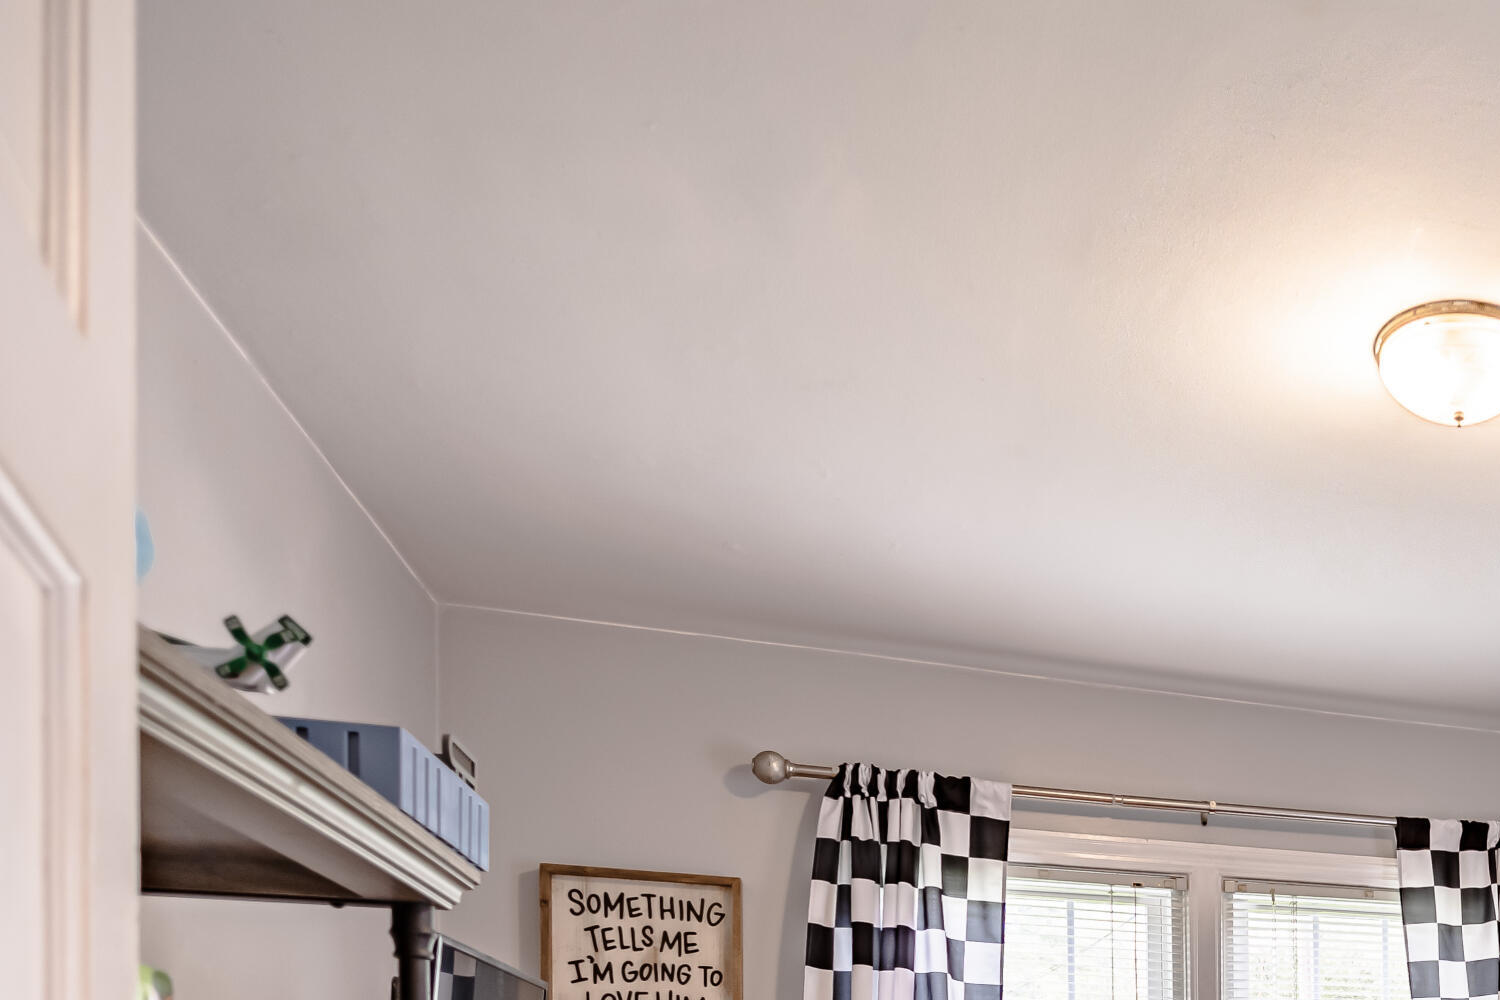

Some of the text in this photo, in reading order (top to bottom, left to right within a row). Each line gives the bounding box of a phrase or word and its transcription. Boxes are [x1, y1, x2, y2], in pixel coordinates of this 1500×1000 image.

[567, 888, 726, 926] SOMETHING
[584, 925, 700, 957] TELLS ME
[567, 955, 723, 987] I'M GOING TO
